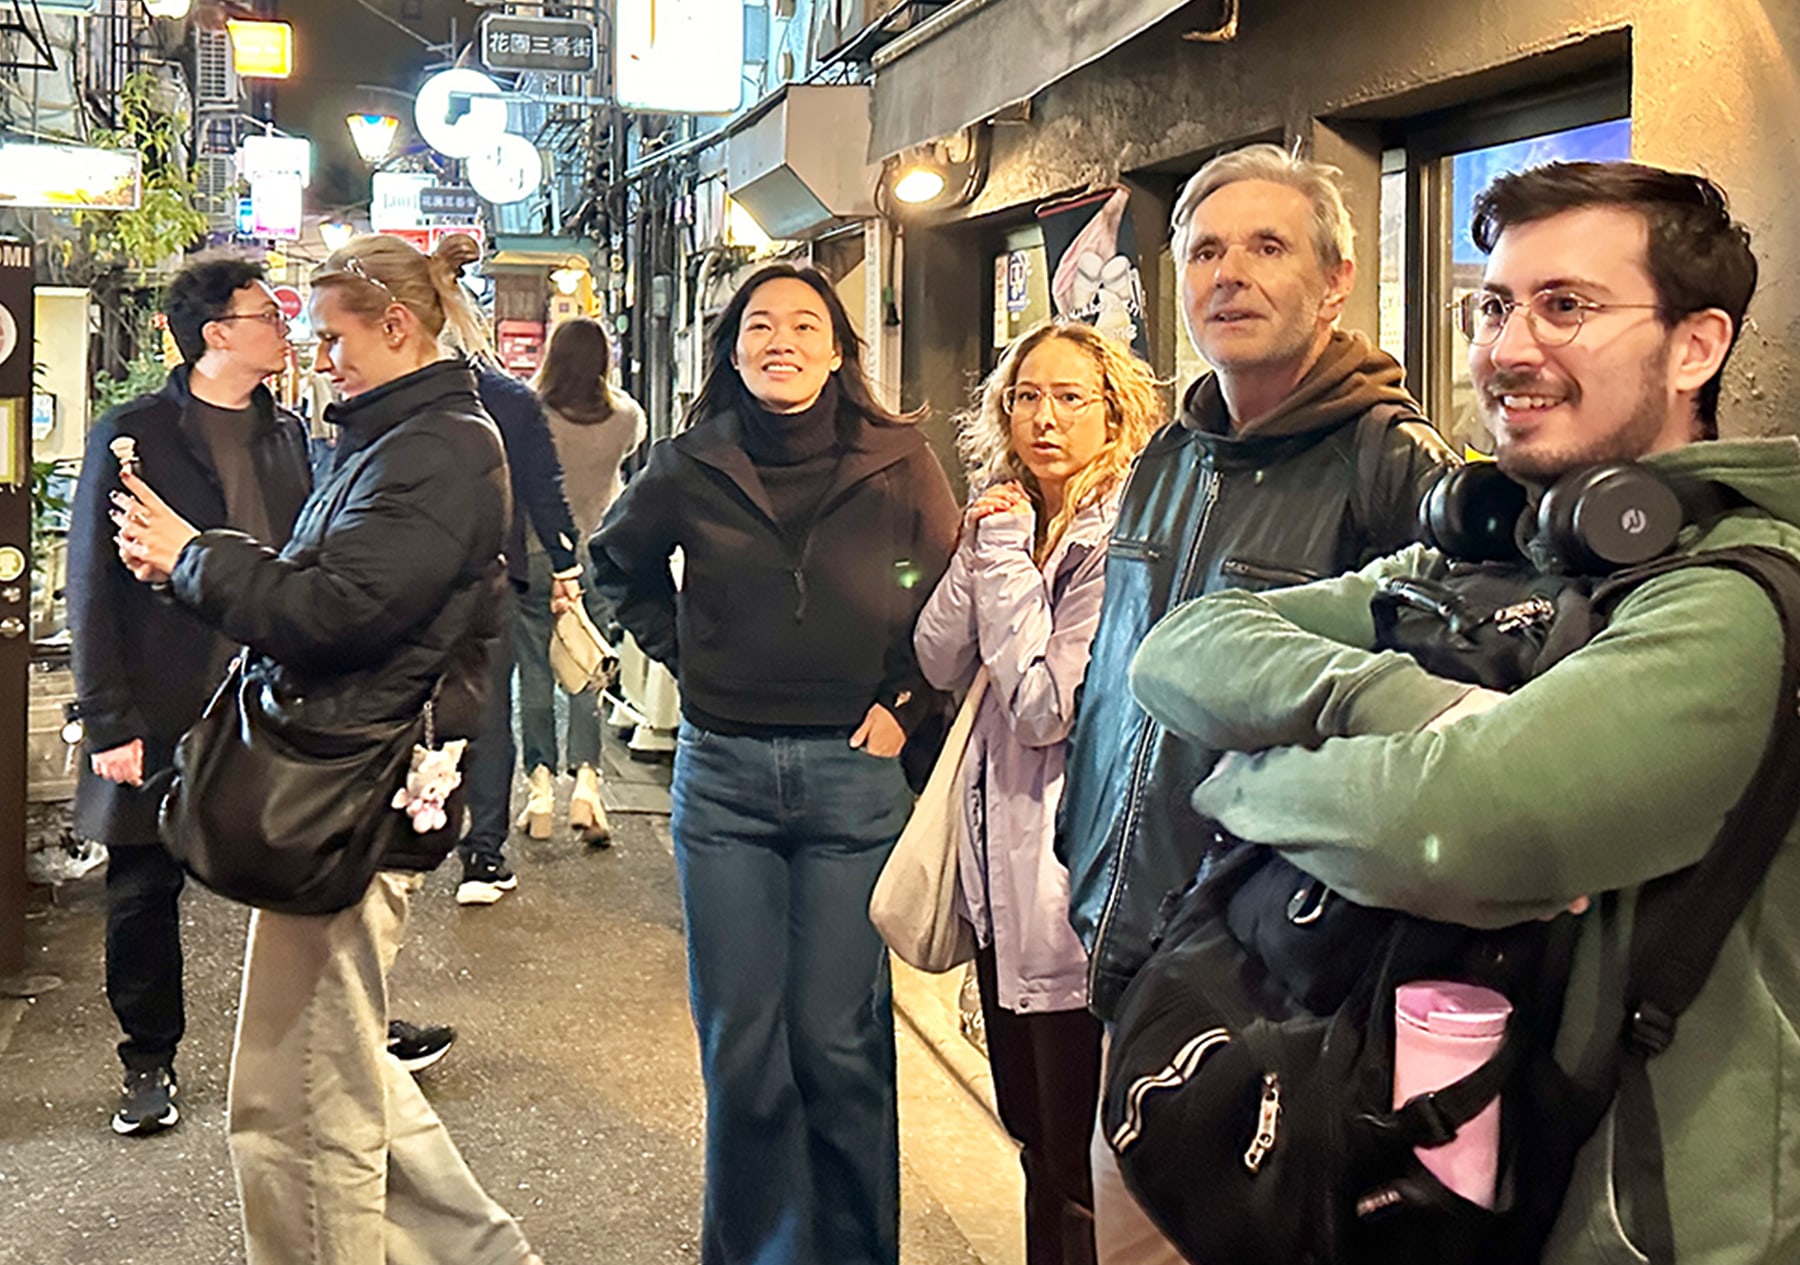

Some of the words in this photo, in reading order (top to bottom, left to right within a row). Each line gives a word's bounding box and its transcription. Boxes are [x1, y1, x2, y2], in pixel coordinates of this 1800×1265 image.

[489, 32, 592, 58] 花園三番街
[0, 245, 31, 267] MI
